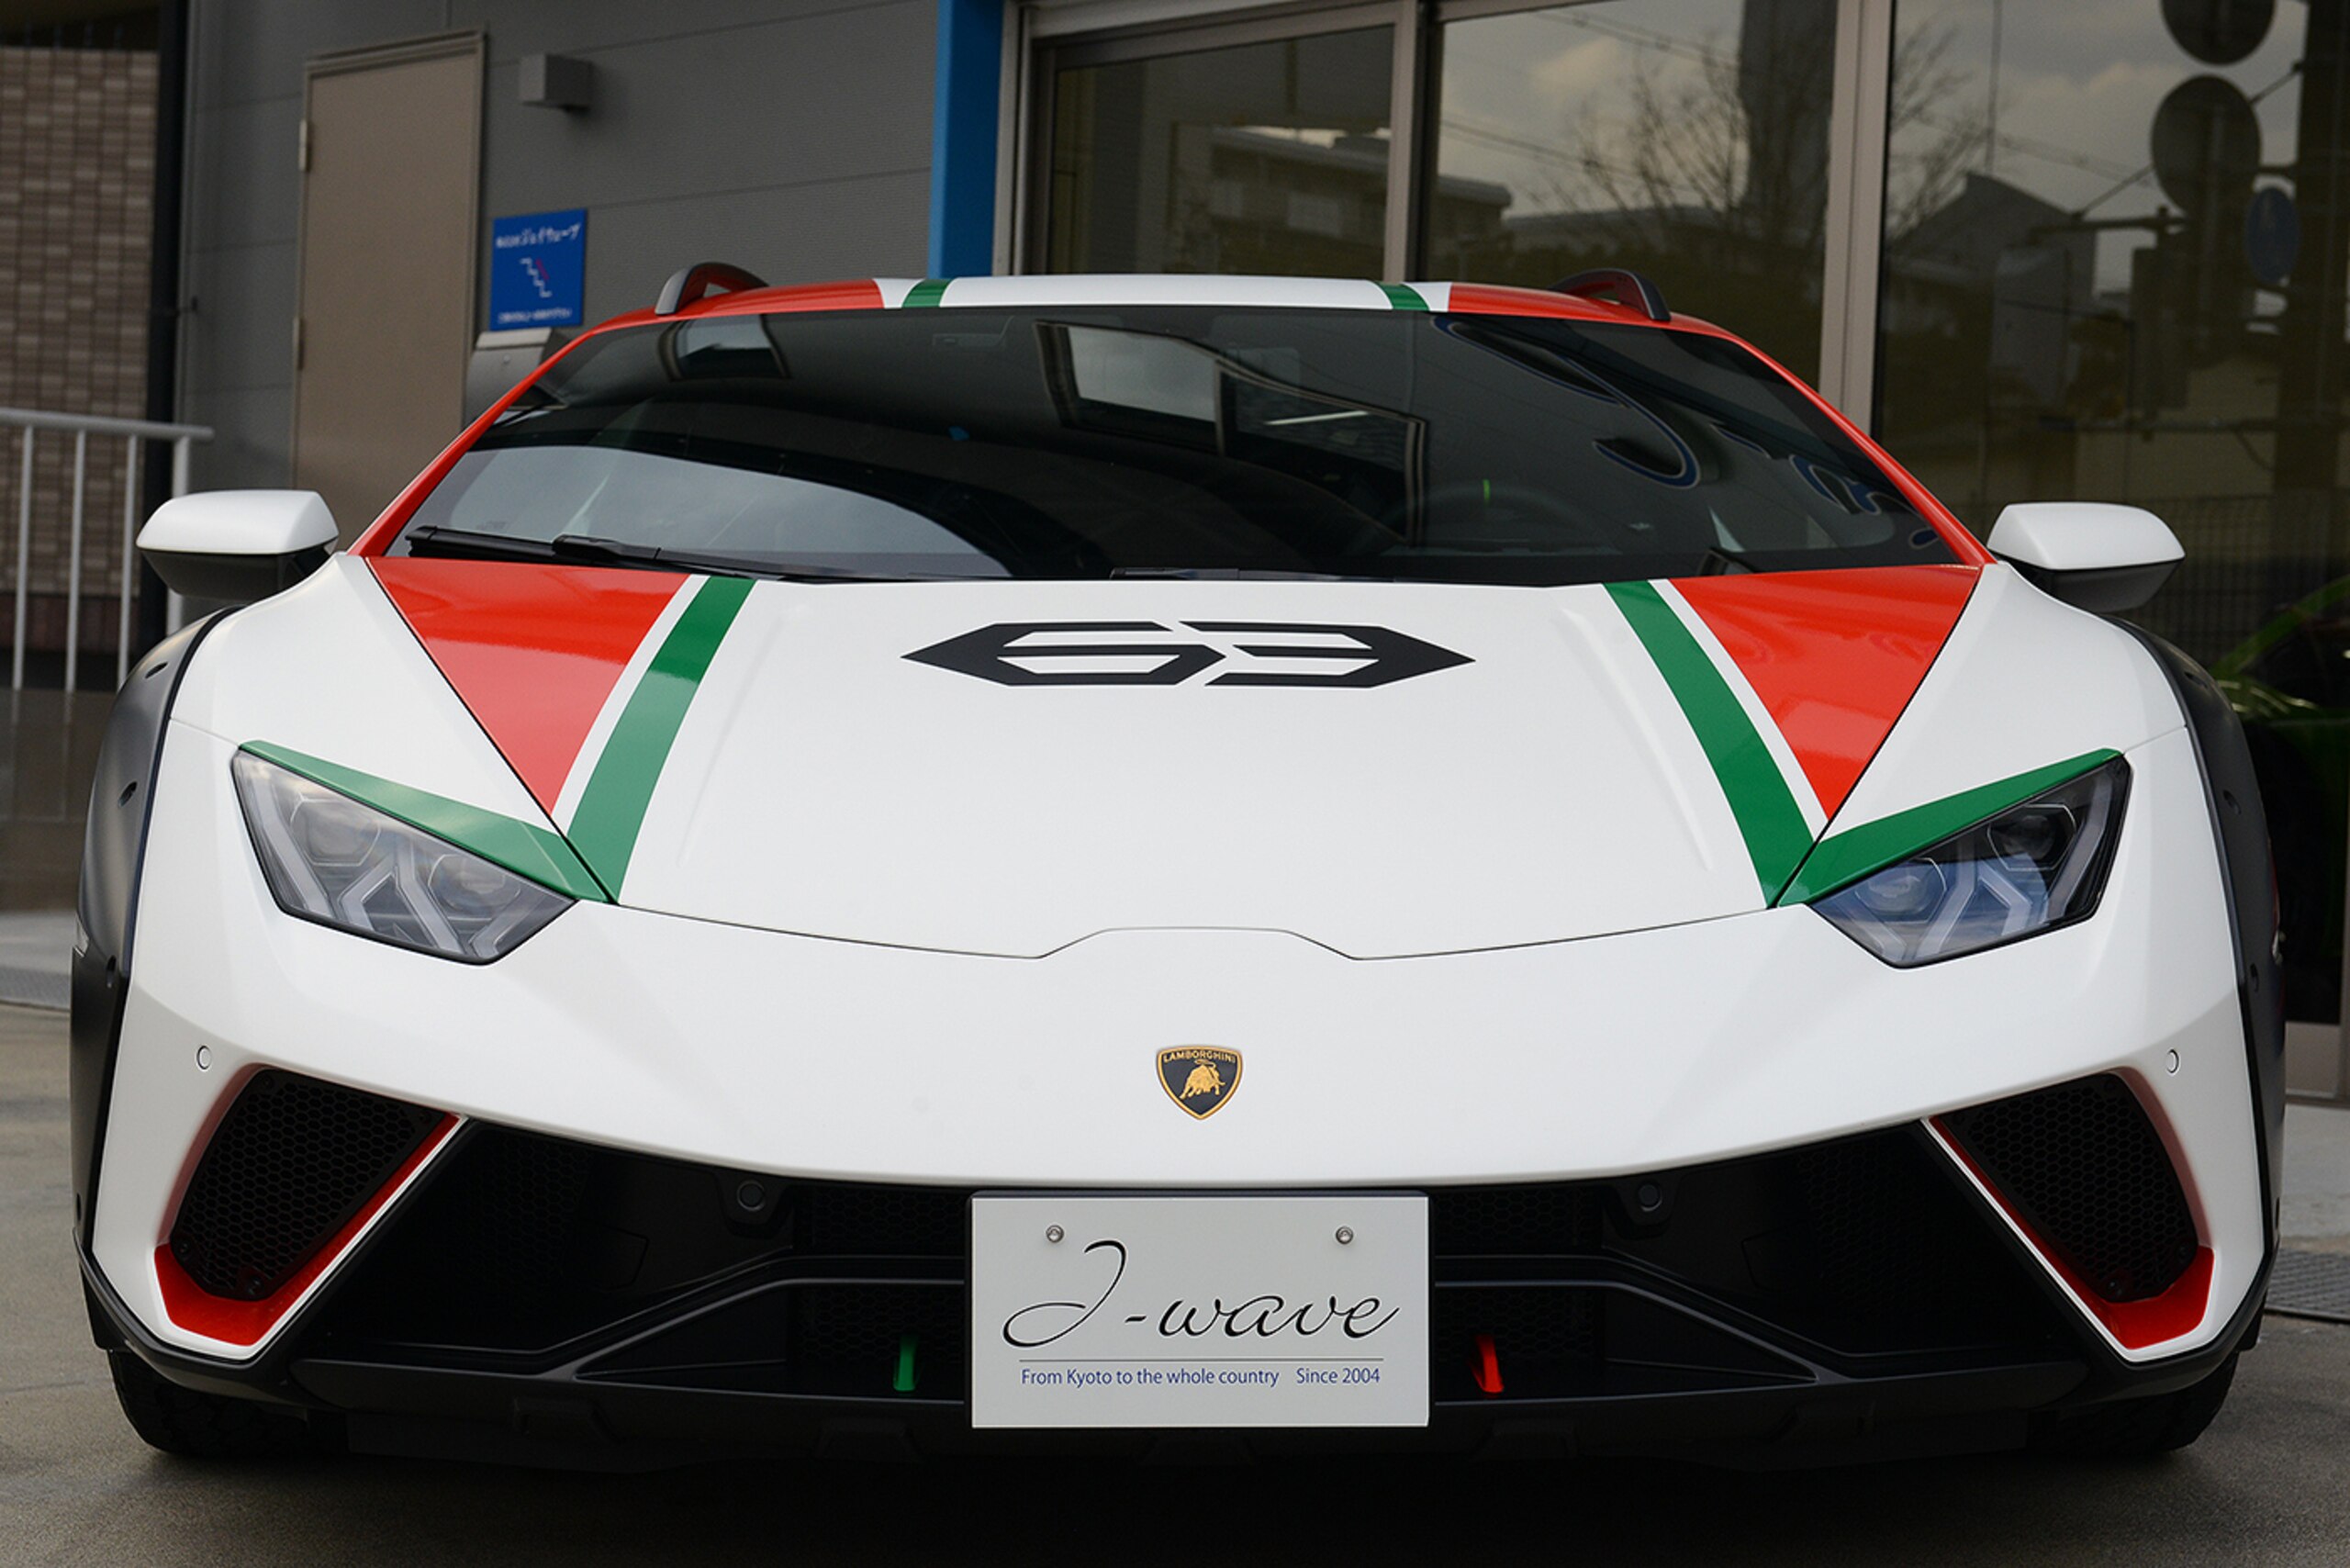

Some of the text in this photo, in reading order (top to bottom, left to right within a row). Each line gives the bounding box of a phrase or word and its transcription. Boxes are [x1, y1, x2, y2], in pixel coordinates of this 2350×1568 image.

[901, 621, 1476, 689] 63
[1163, 1050, 1237, 1063] LAMBORGHINI
[1002, 1239, 1400, 1349] J-wave
[1022, 1368, 1380, 1388] From Kyoto to the whole country Since 2004
